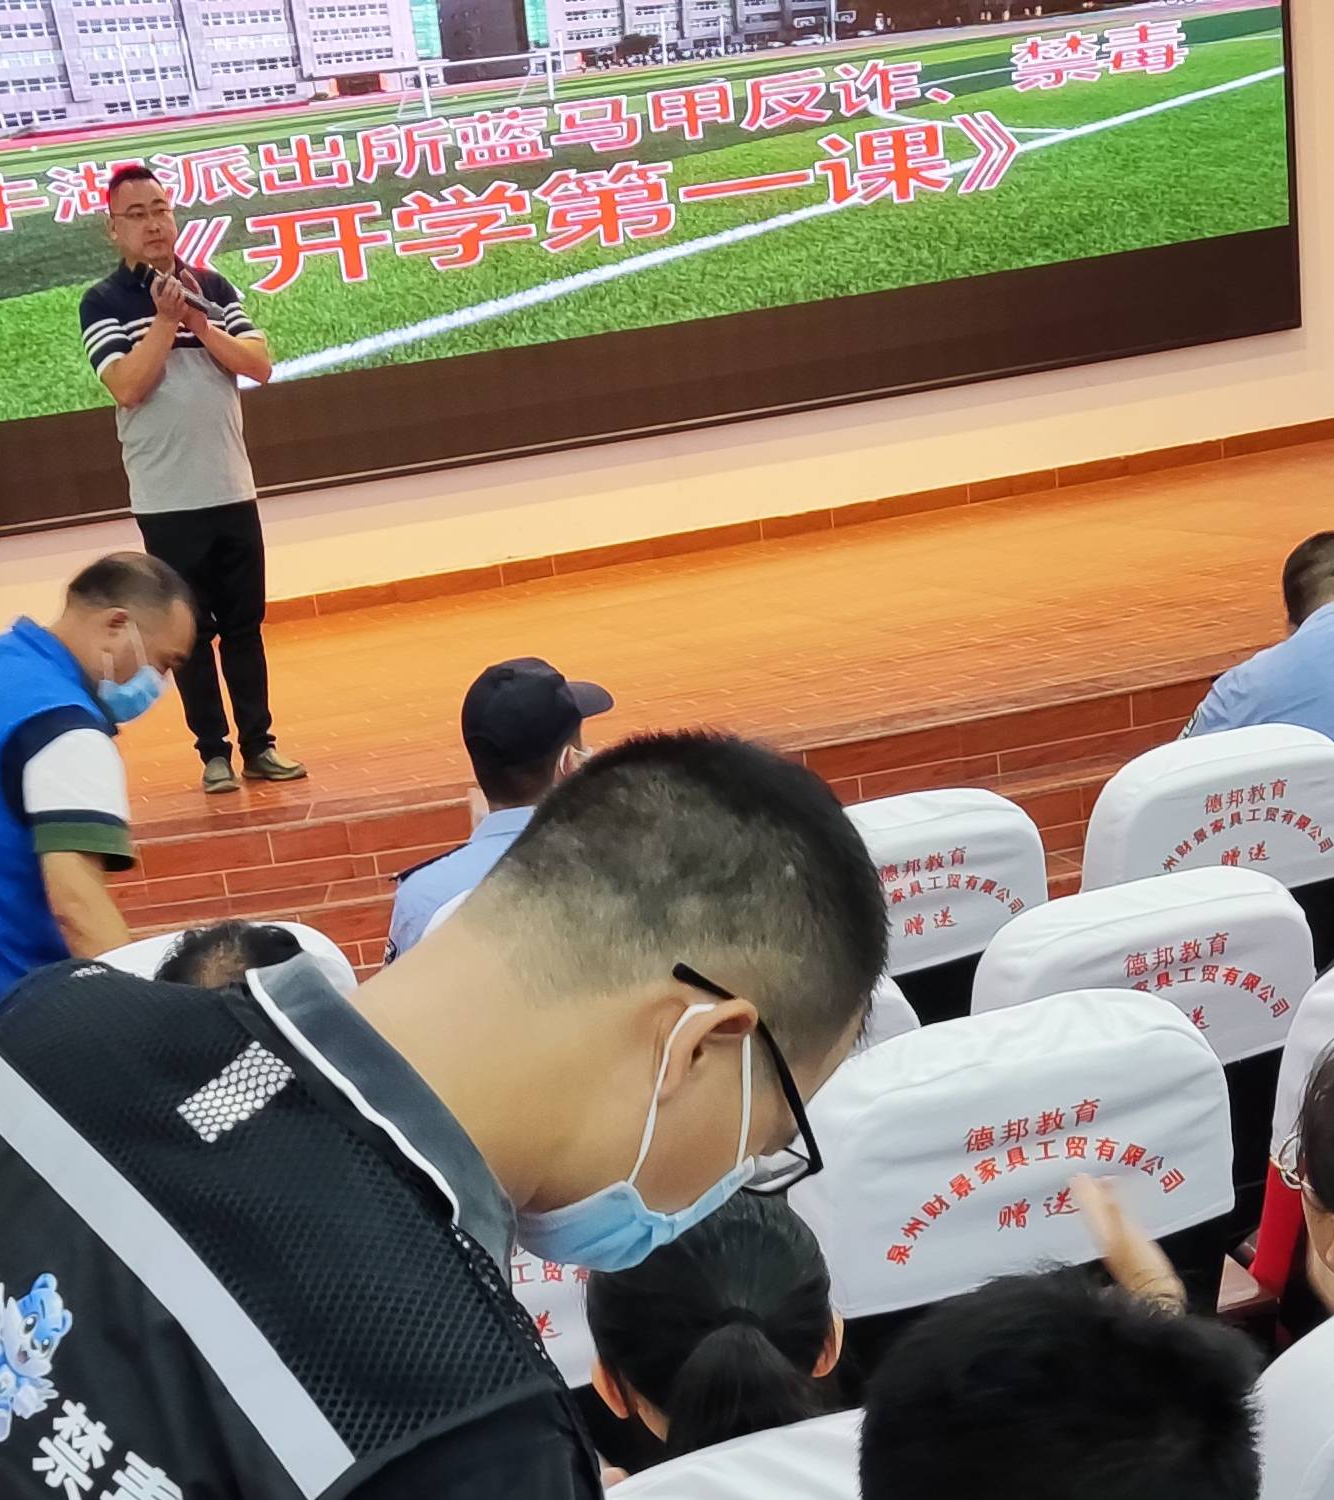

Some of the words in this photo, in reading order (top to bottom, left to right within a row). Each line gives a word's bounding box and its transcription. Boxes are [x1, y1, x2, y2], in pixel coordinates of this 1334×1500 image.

[1203, 778, 1289, 816] 德邦教育
[878, 846, 968, 884] 德邦教育
[903, 906, 959, 938] 赠送
[1123, 931, 1231, 978] 德邦教育
[963, 1097, 1101, 1154] 德邦教育
[883, 1135, 1186, 1266] 泉州财景家具工贸有限公司
[997, 1186, 1082, 1233] 赠送
